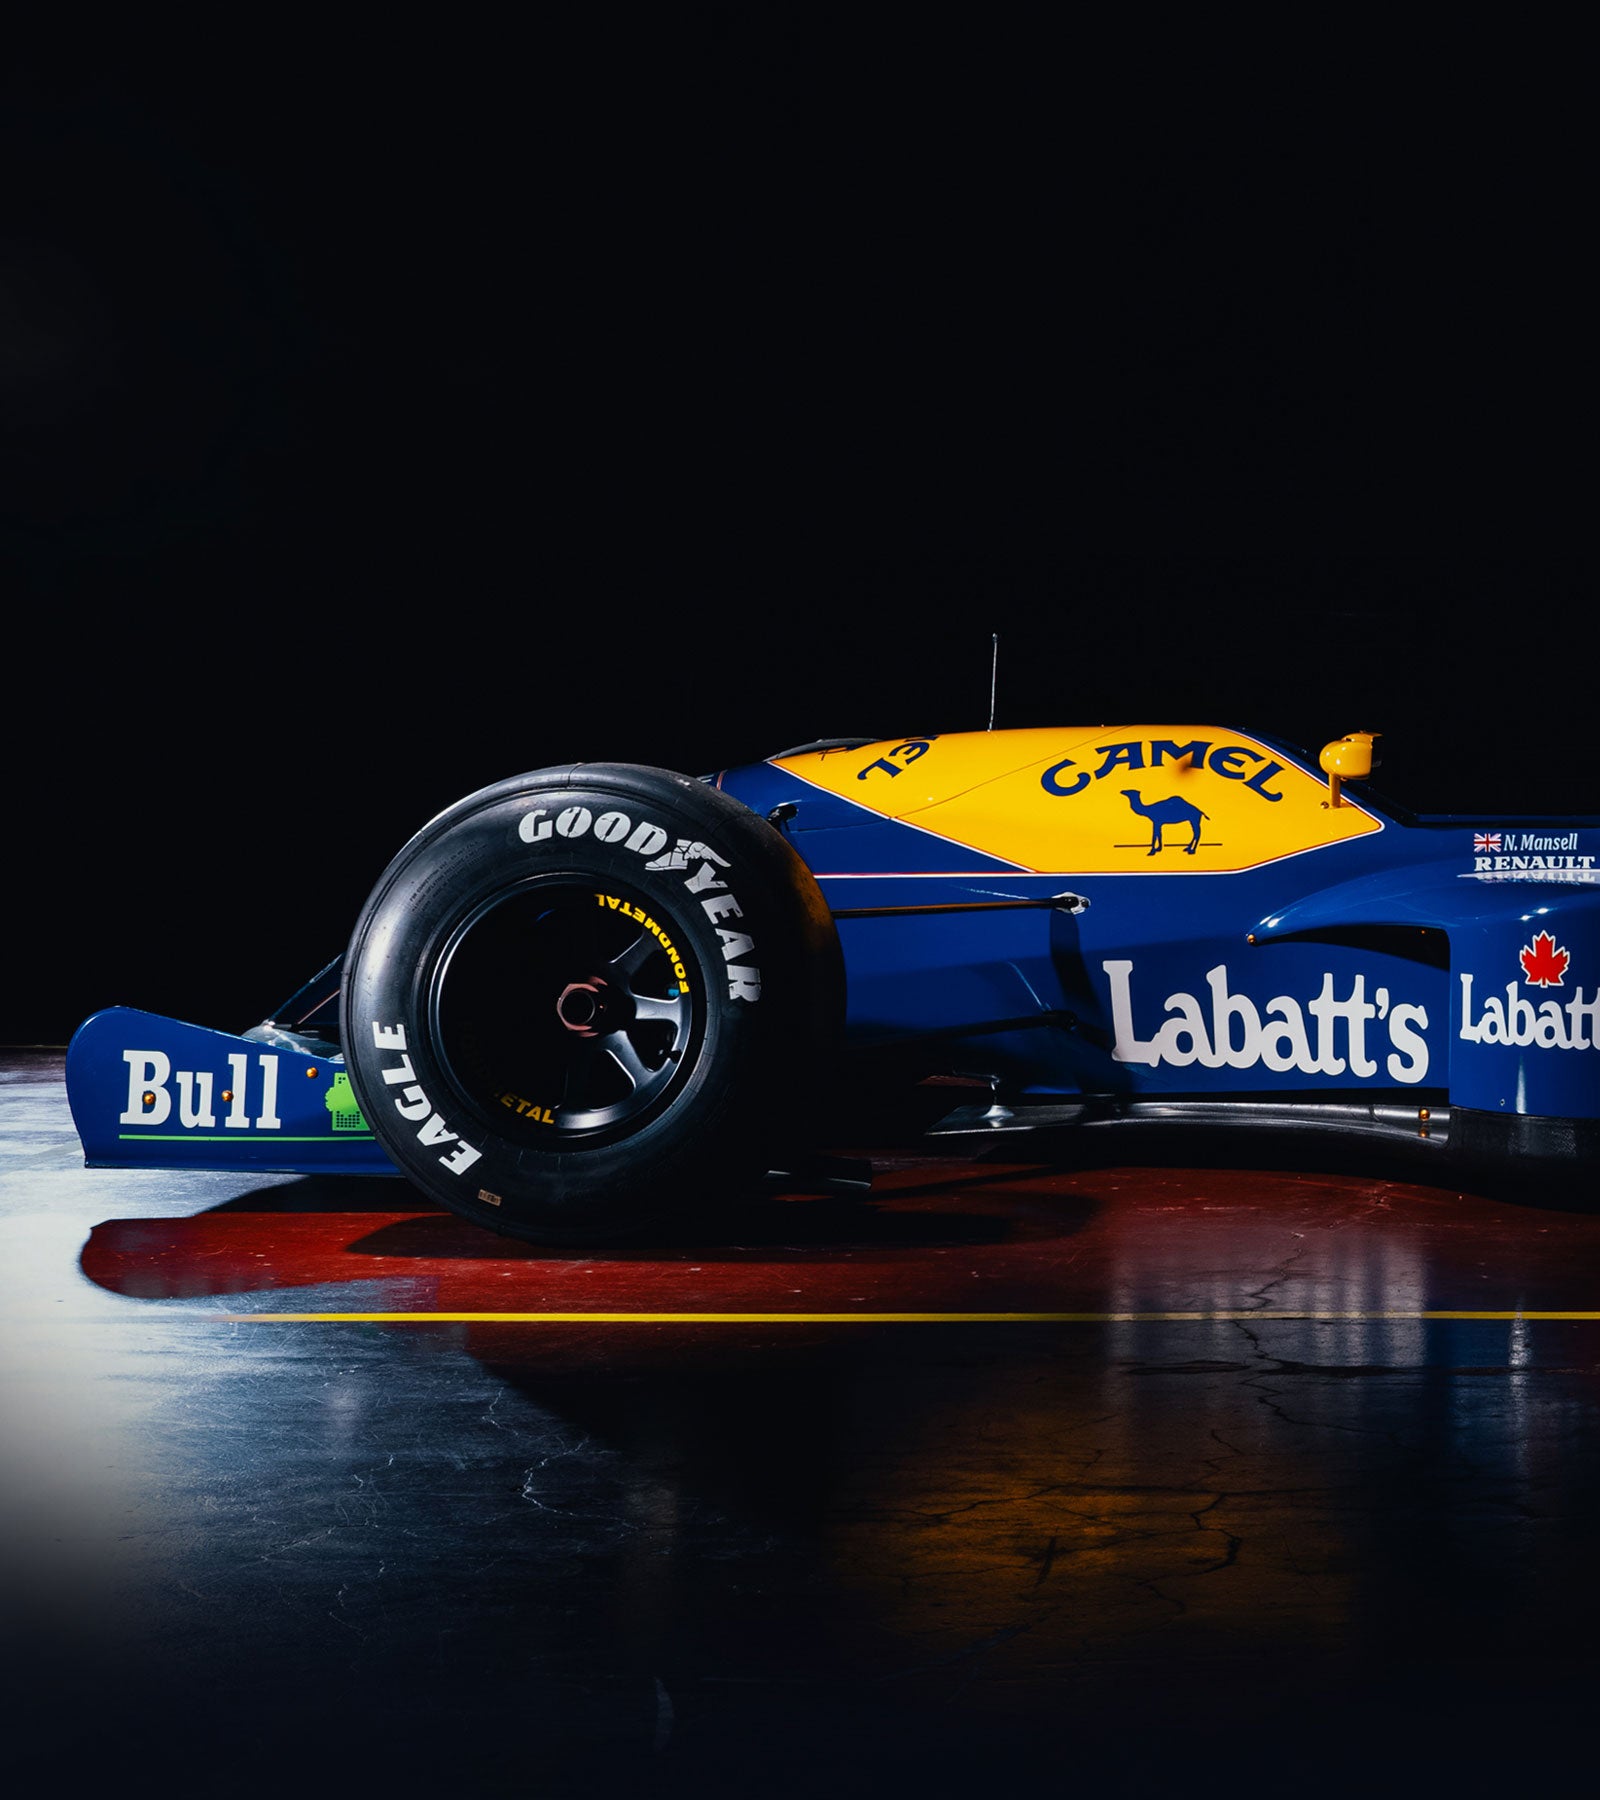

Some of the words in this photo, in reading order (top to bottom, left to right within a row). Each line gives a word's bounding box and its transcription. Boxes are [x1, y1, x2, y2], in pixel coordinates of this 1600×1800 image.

[856, 735, 939, 781] EL
[1039, 739, 1286, 802] CAMEL
[1473, 855, 1596, 872] RENAULT
[1520, 832, 1579, 852] Mansell
[593, 892, 691, 995] FONDMETAL
[1102, 958, 1430, 1085] Labatt's
[118, 1049, 282, 1129] Bull
[372, 1020, 484, 1176] EAGLE
